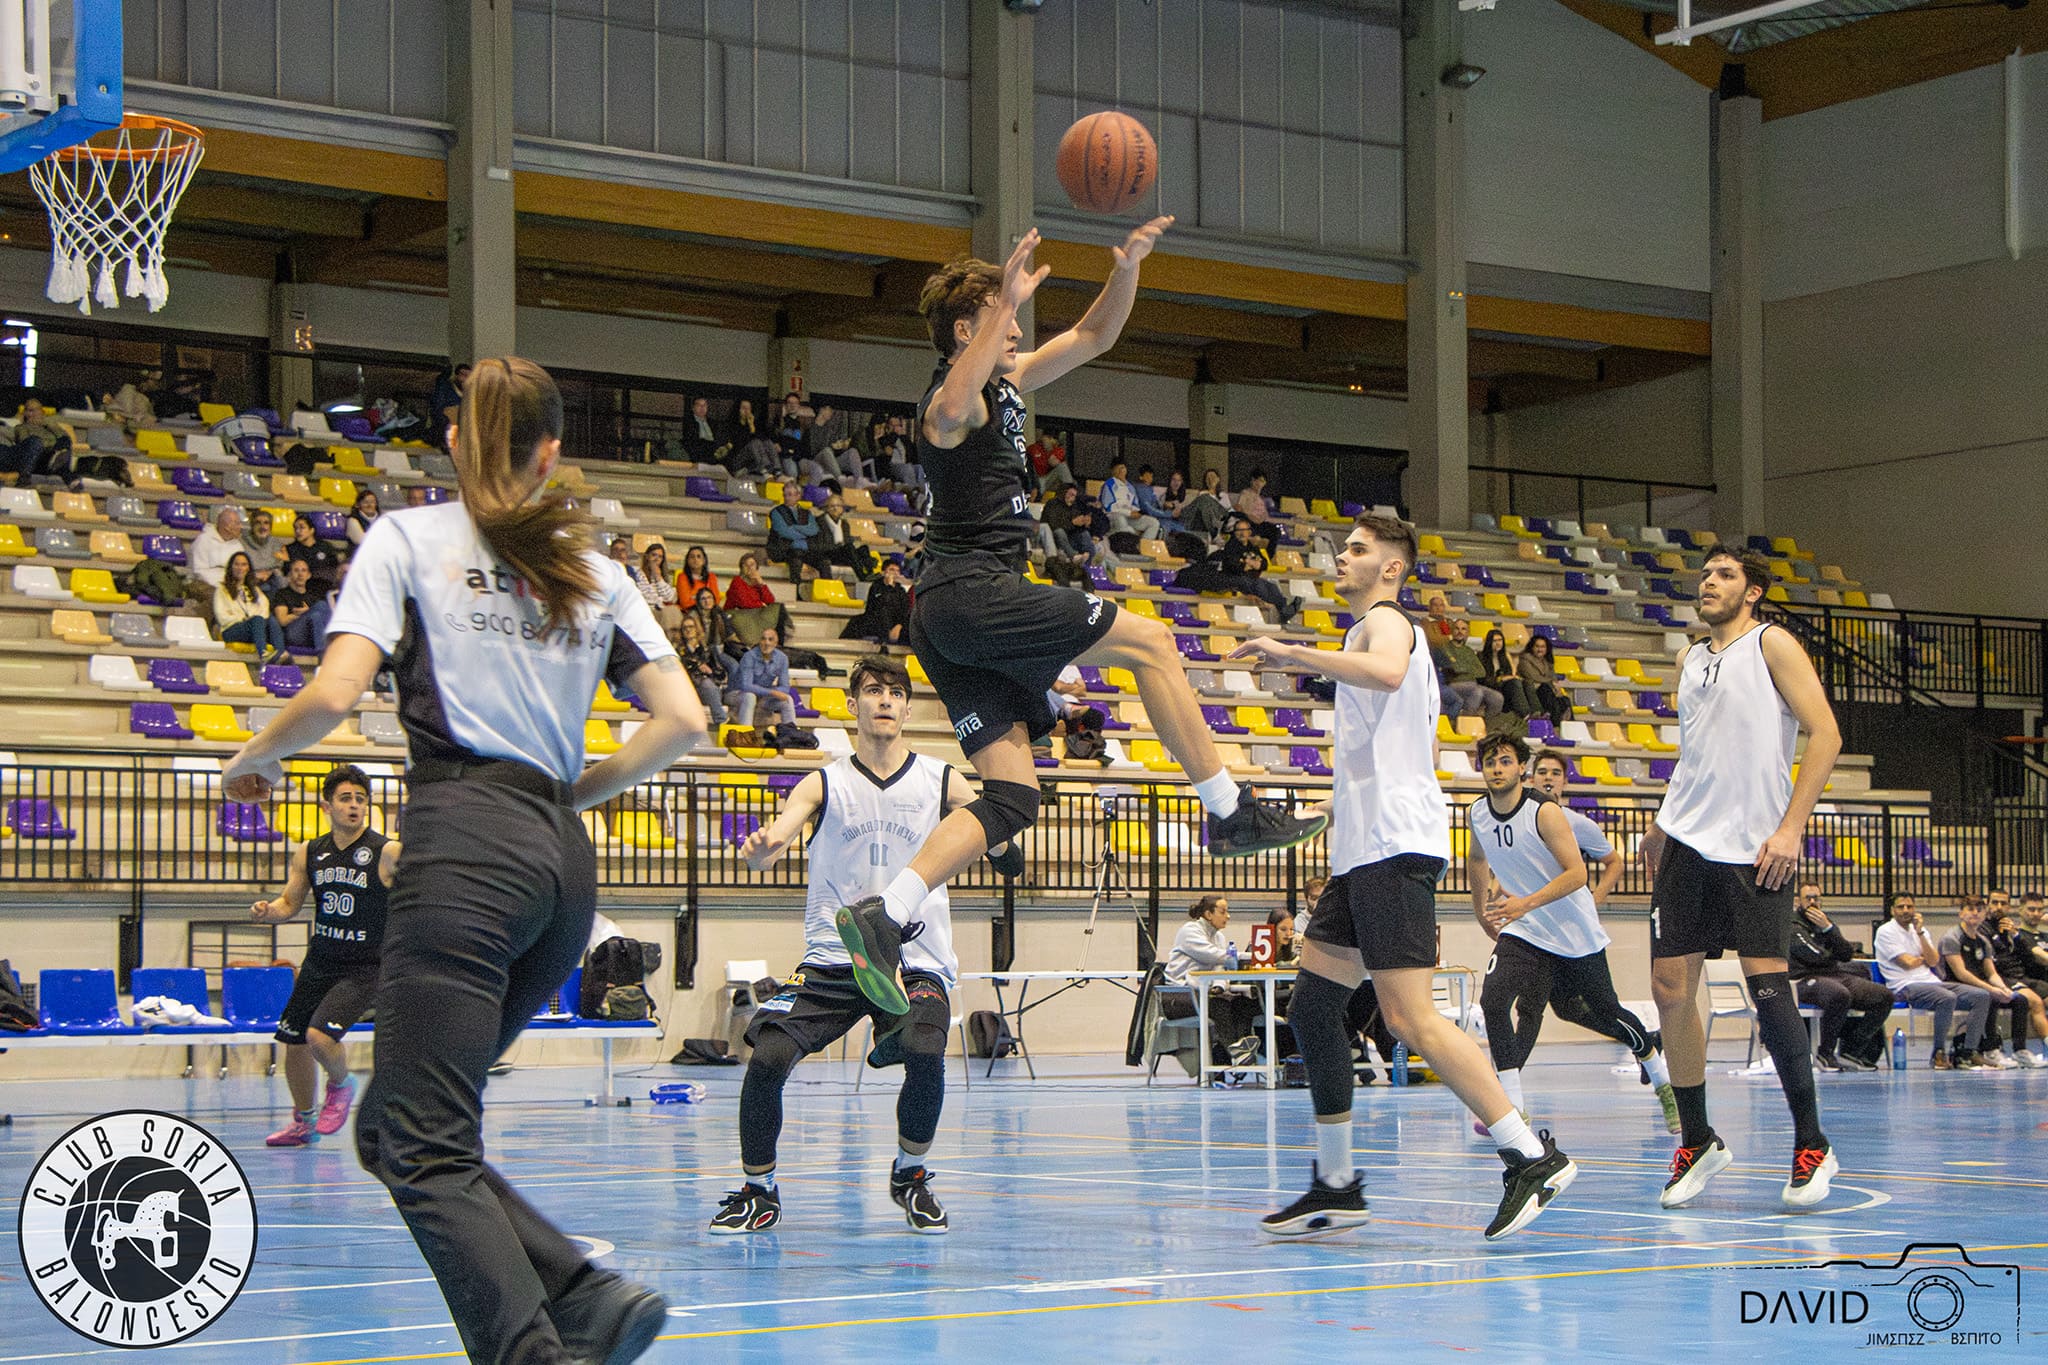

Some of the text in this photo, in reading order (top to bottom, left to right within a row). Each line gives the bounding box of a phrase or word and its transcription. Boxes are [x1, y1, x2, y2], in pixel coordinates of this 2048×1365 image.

[471, 612, 516, 636] 900
[1702, 656, 1723, 688] 11
[1493, 824, 1513, 848] 10
[315, 866, 367, 888] SORIA
[323, 891, 355, 916] 30
[1254, 929, 1272, 962] 5
